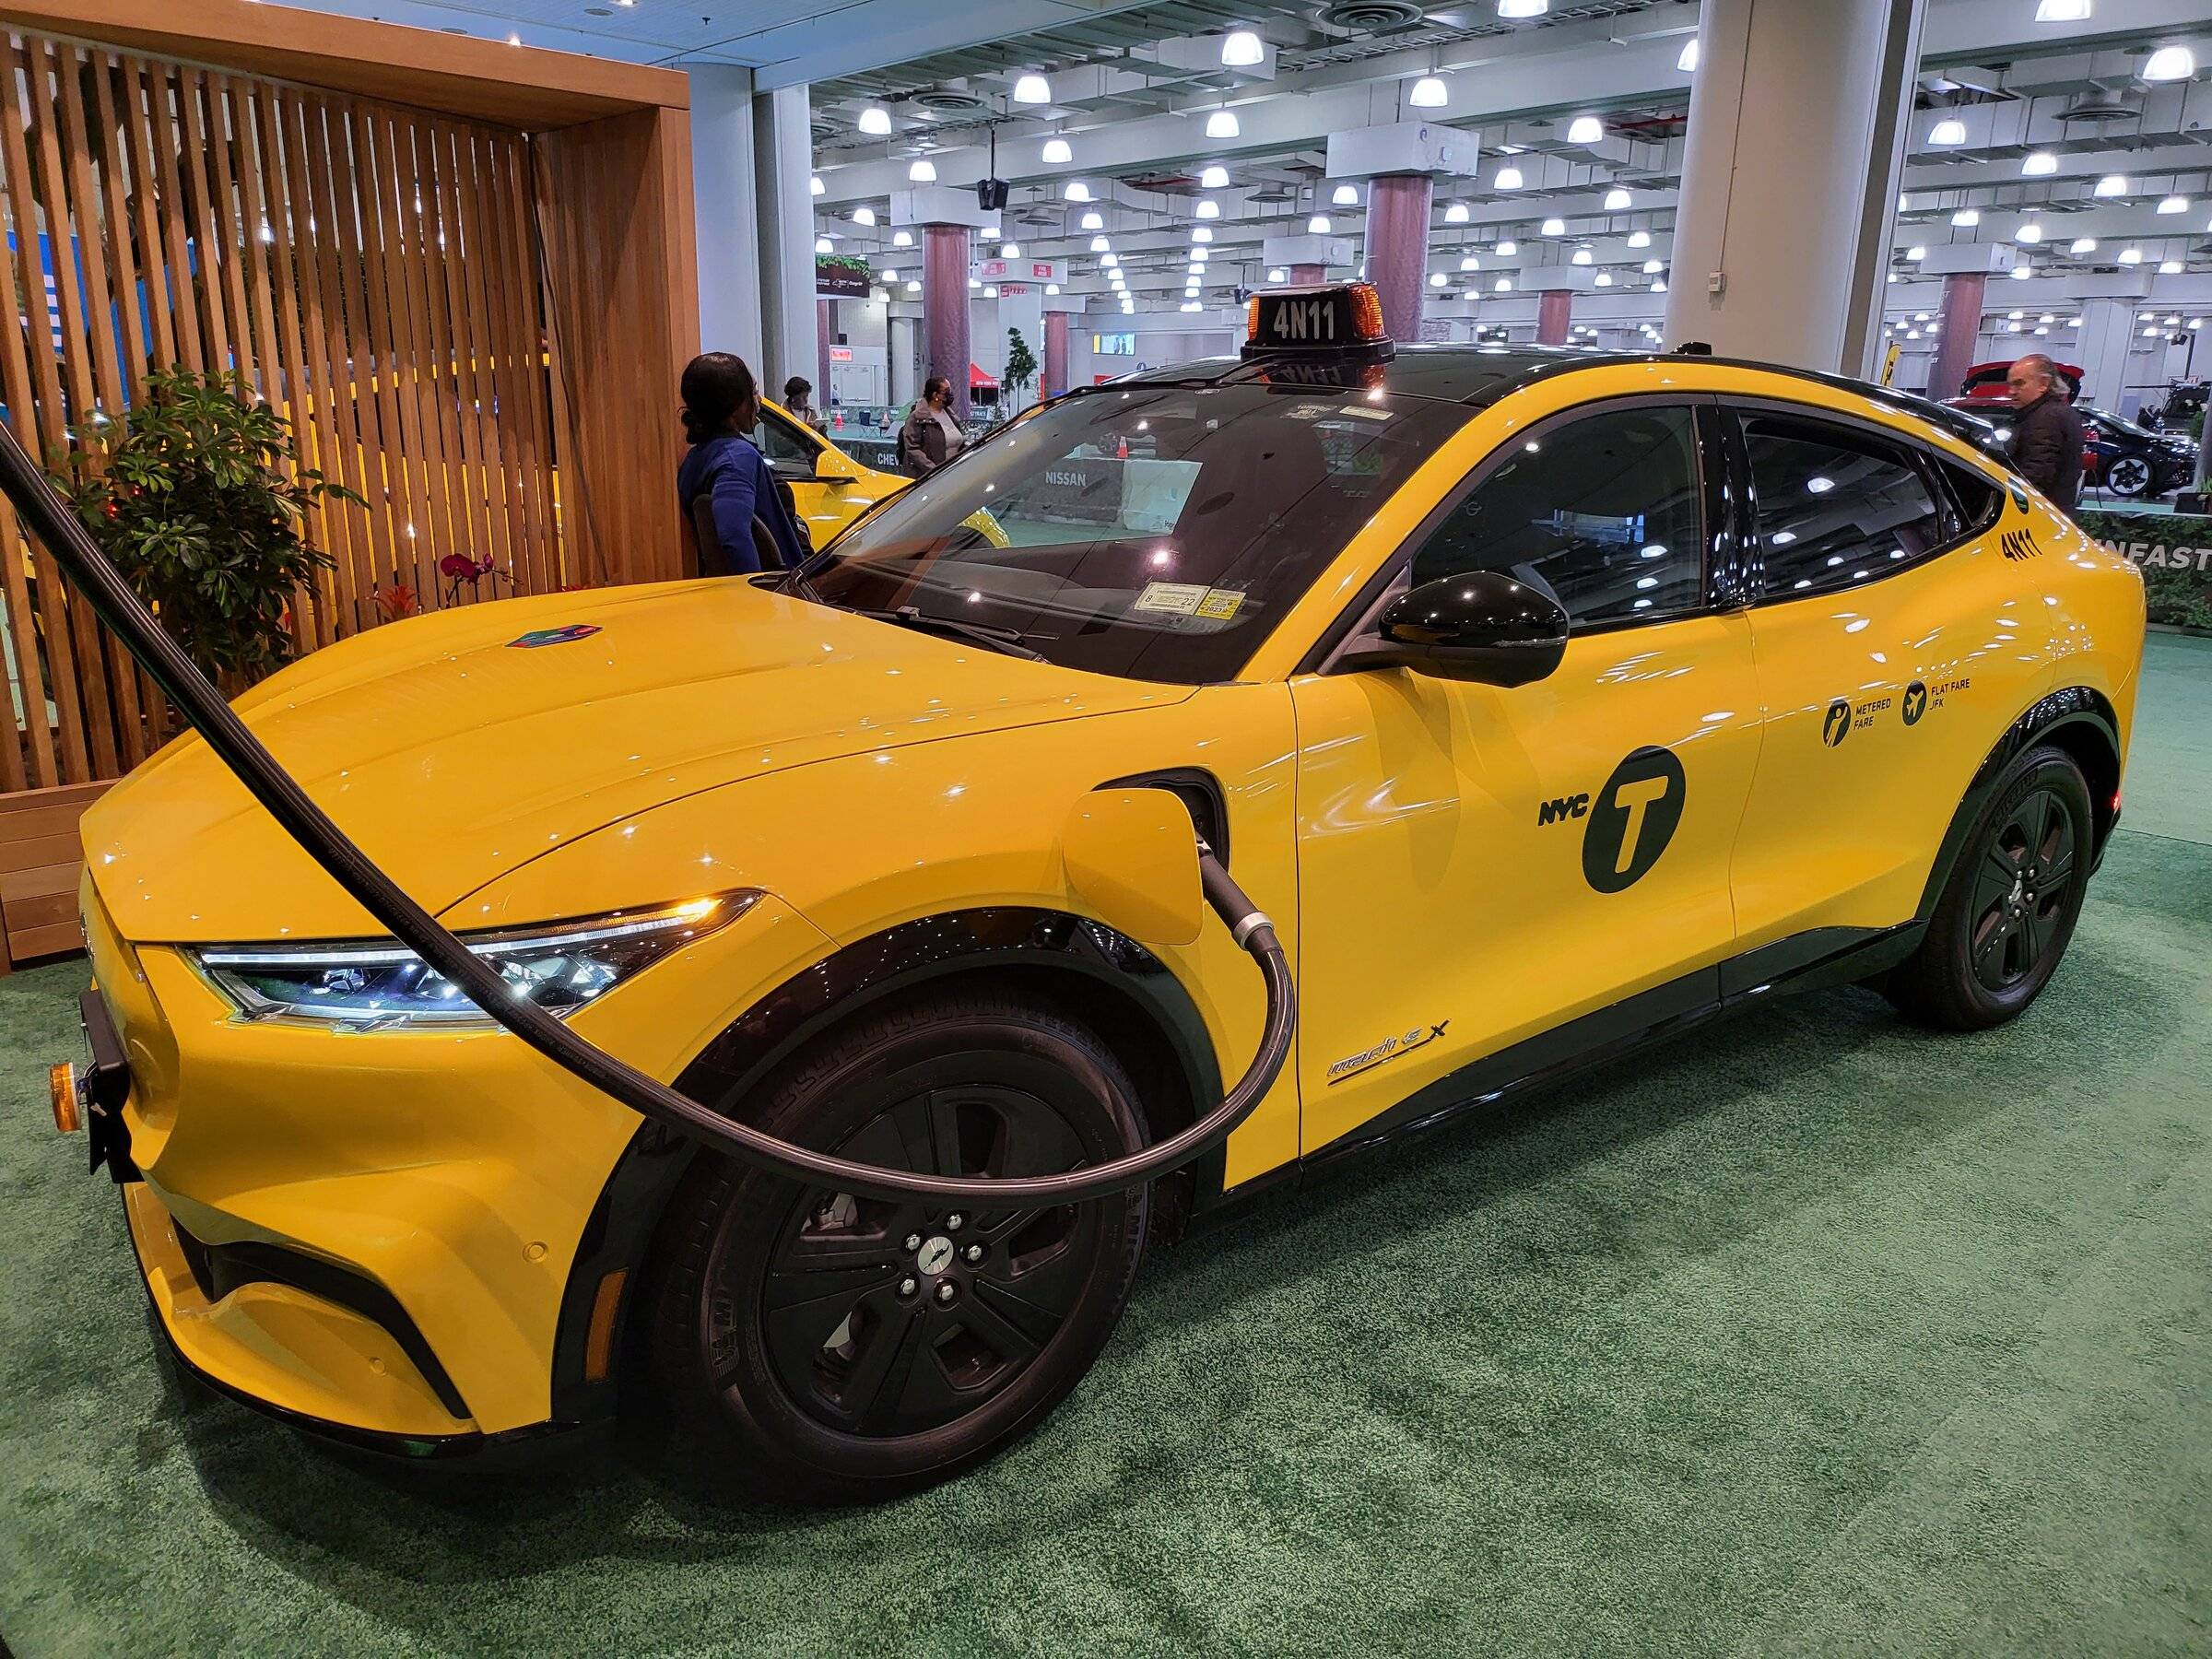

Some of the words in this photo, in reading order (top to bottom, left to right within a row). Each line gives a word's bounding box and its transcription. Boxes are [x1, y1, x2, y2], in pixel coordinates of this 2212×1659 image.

[1273, 300, 1334, 340] 4N11
[1045, 471, 1087, 487] NISSAN
[2000, 528, 2042, 562] 4N11
[2094, 538, 2212, 571] NFAST
[1181, 597, 1195, 606] 22
[1931, 683, 1949, 697] FLAT
[1950, 678, 1971, 693] FARE
[1854, 698, 1891, 717] METERED
[1929, 697, 1945, 711] JFK
[1853, 716, 1875, 731] FARE
[1537, 793, 1590, 827] NYC
[1614, 775, 1670, 875] T
